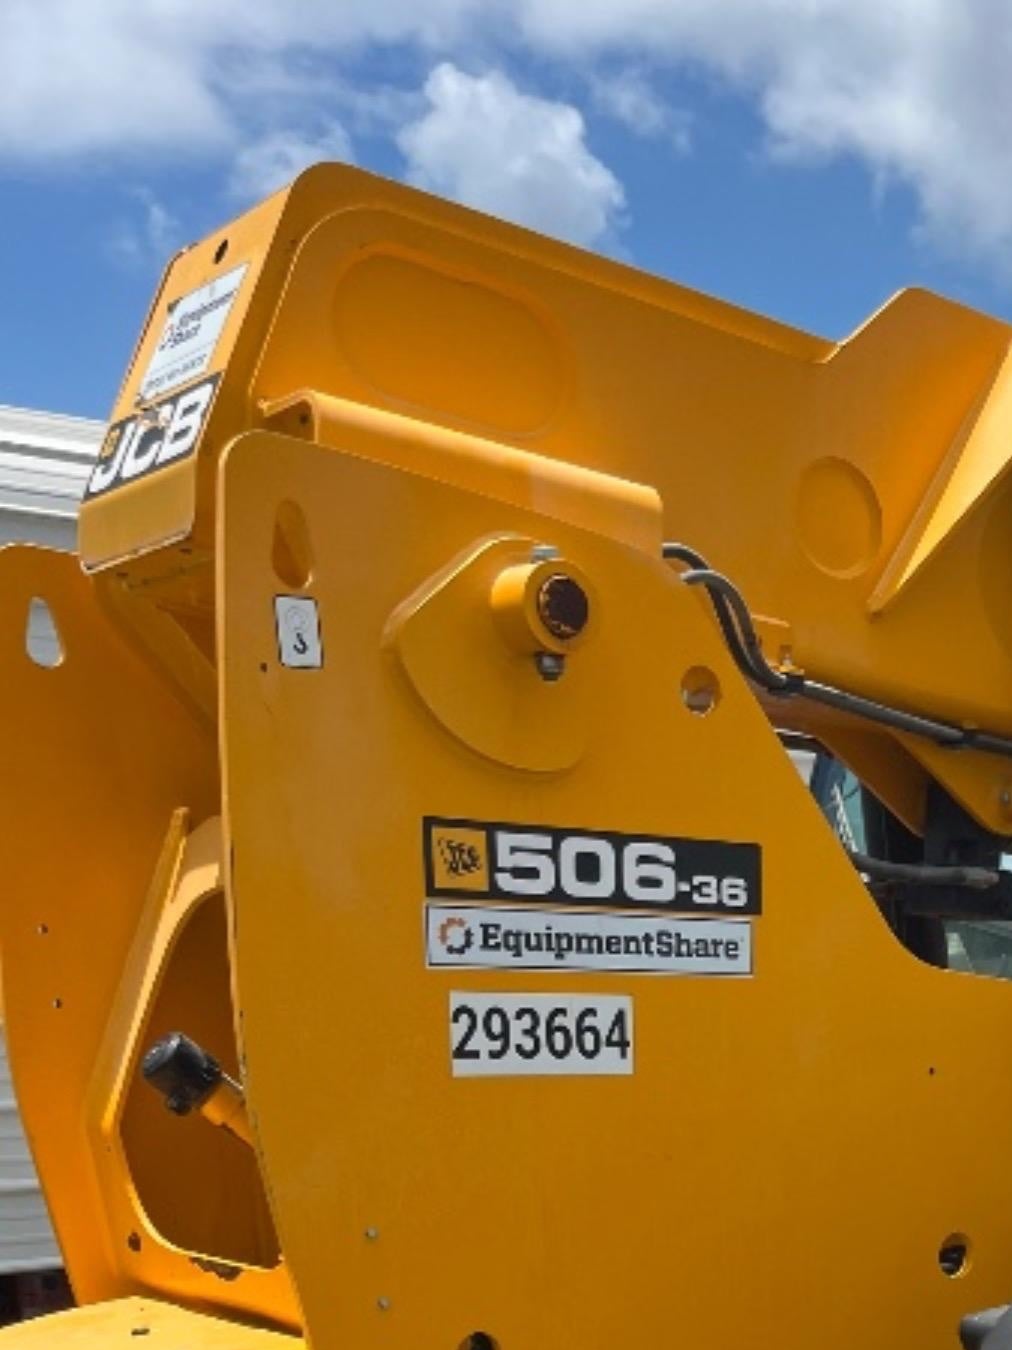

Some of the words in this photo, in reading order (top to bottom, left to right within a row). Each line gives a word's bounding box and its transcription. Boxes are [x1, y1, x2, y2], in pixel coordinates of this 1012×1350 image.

[89, 382, 214, 493] JCB
[494, 832, 748, 907] 506-36
[480, 922, 740, 961] EquipmentShare
[451, 1004, 631, 1061] 293664
